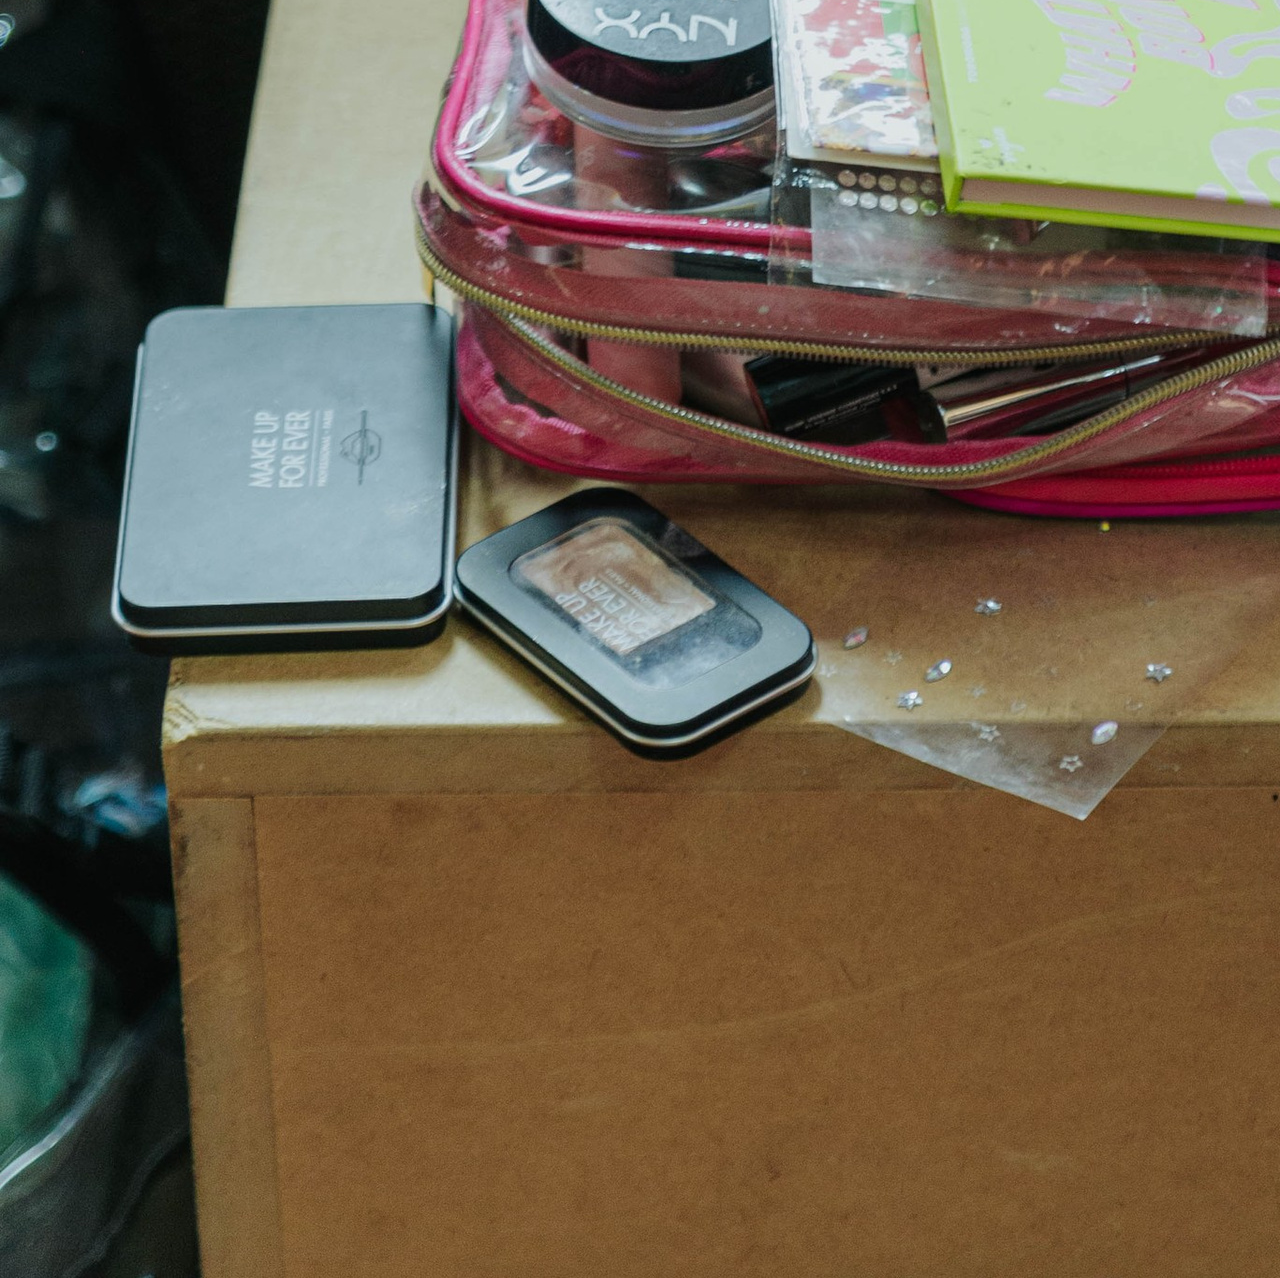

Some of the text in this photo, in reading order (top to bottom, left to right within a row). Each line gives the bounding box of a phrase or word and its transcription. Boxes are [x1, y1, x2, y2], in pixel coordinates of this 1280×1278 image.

[592, 7, 738, 46] NYX
[248, 411, 279, 488] MAKE UP
[278, 410, 311, 488] FOR EVER
[555, 592, 641, 653] MAKE UP
[579, 576, 661, 642] FOR EVER
